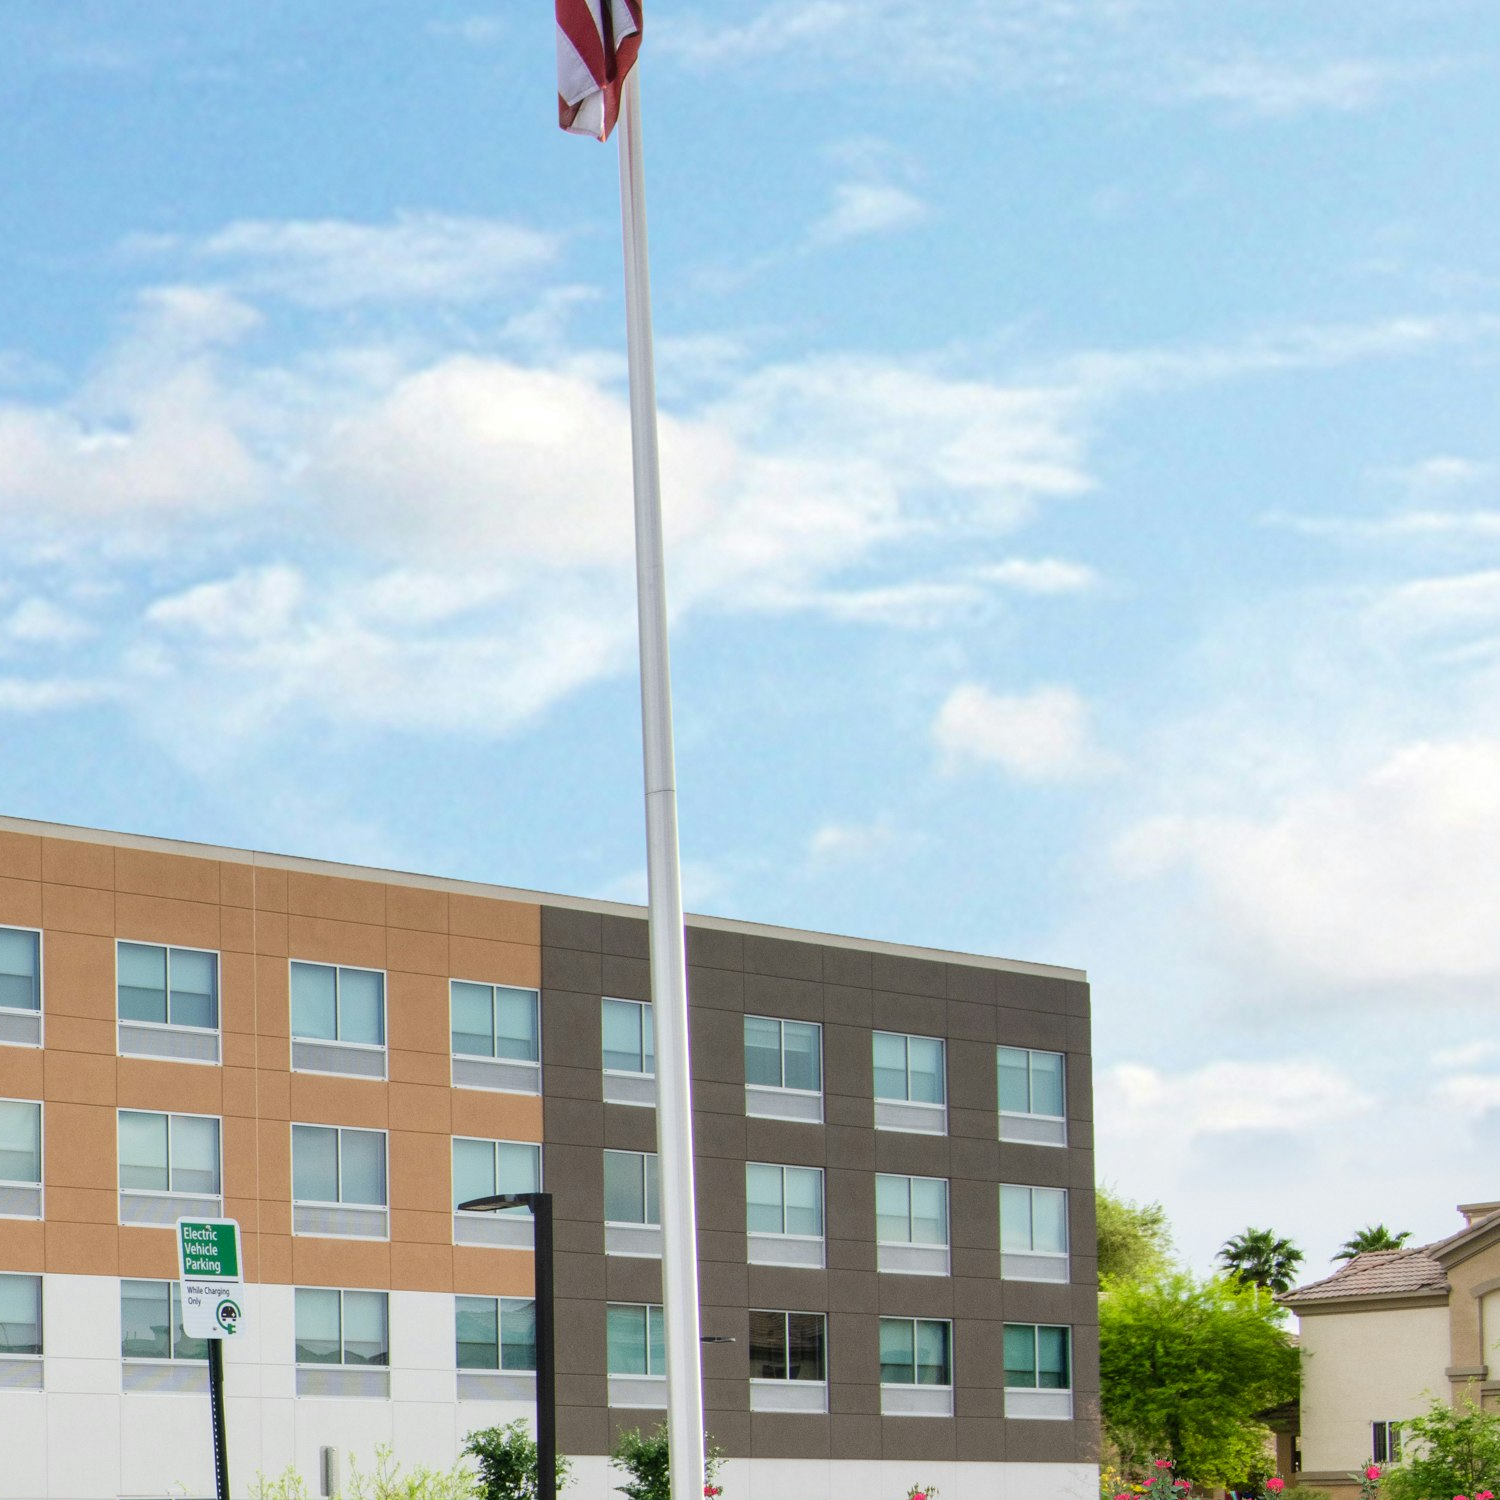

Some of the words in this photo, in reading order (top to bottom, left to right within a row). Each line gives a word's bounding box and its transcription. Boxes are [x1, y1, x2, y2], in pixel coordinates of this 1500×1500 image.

[183, 1226, 218, 1241] Electric
[184, 1242, 219, 1256] Vehicle
[185, 1257, 221, 1274] Parking
[187, 1286, 204, 1295] While
[204, 1286, 230, 1297] Charging
[188, 1297, 201, 1307] Only
